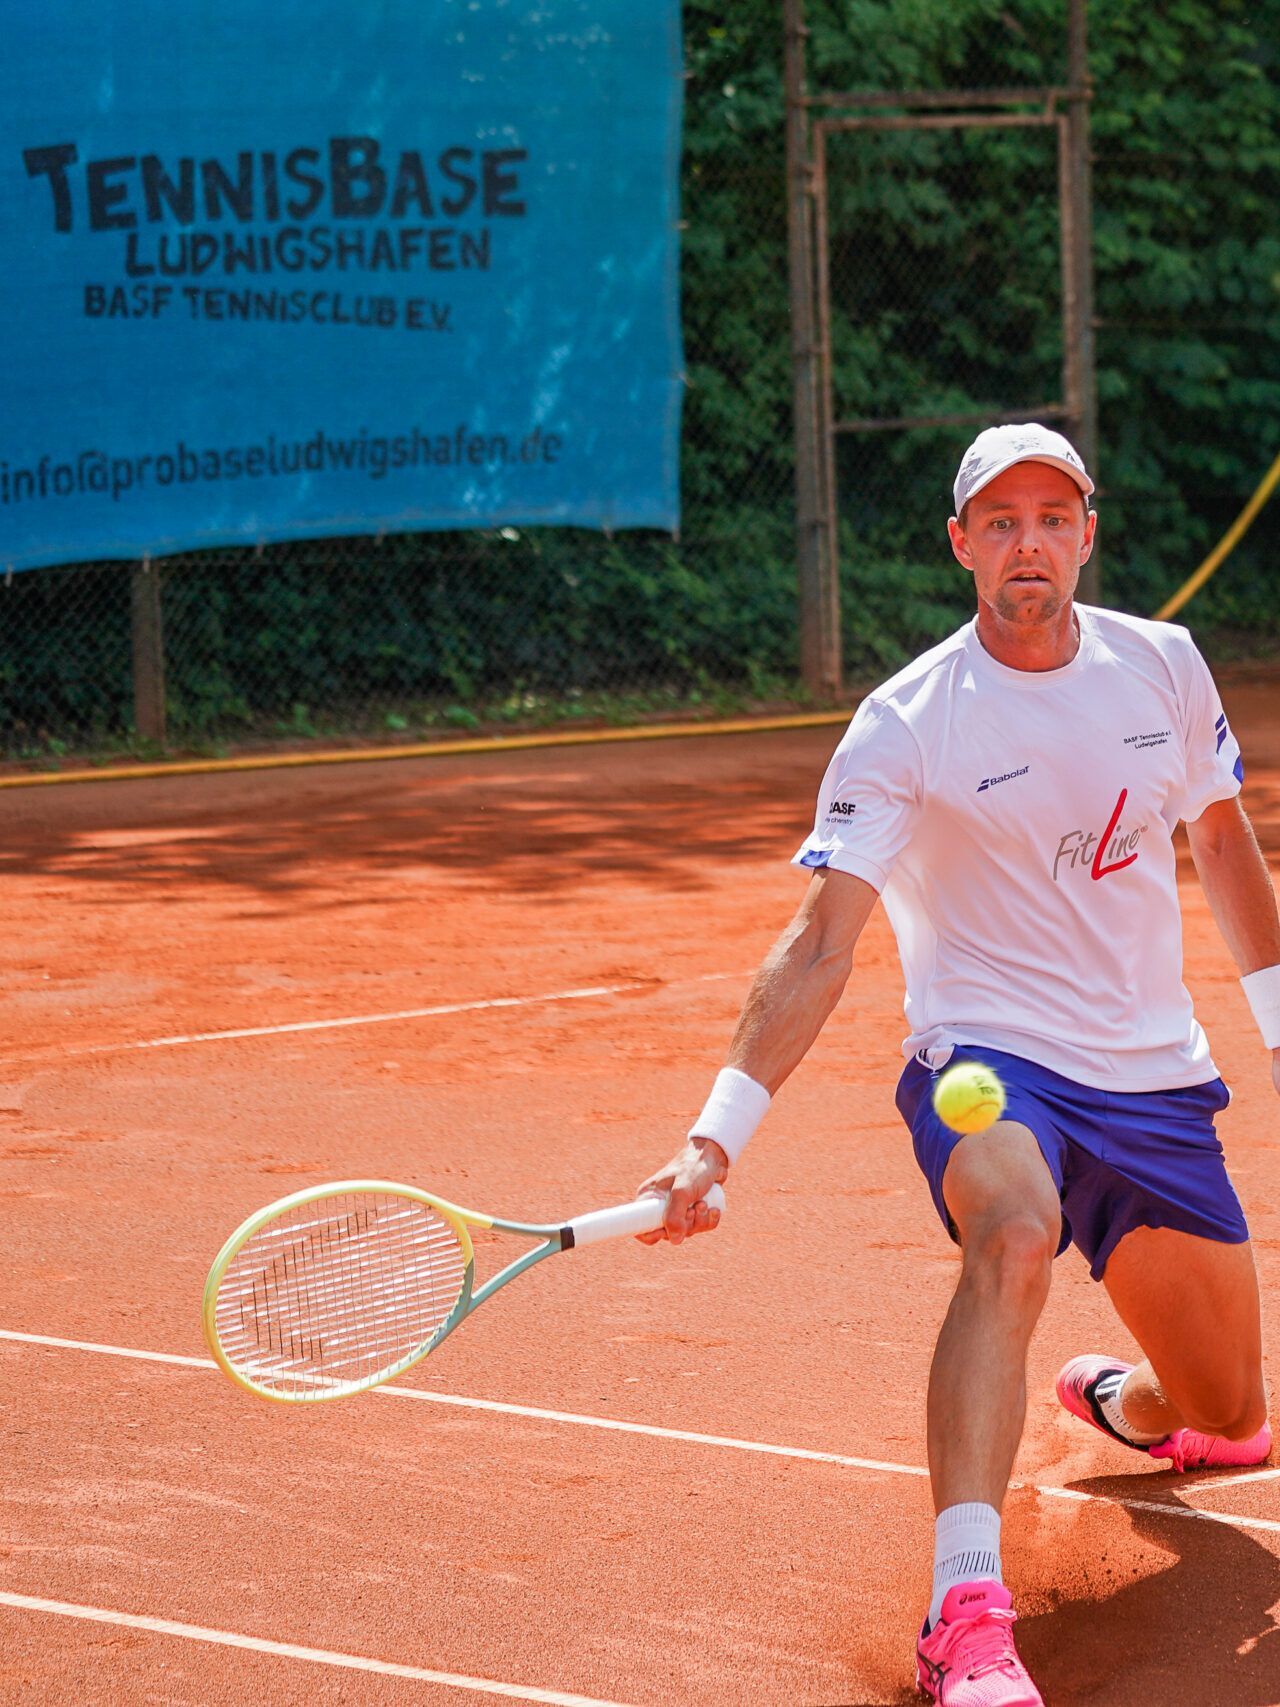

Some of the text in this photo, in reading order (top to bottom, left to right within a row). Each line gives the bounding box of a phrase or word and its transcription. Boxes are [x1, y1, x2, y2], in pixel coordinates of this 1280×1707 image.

[125, 227, 491, 278] LUDWIGSHAFEN
[83, 284, 454, 333] BASF TENNISCLUB E.V.
[0, 425, 563, 502] info@probaseludwigshafen.de
[990, 765, 1030, 786] Babolat
